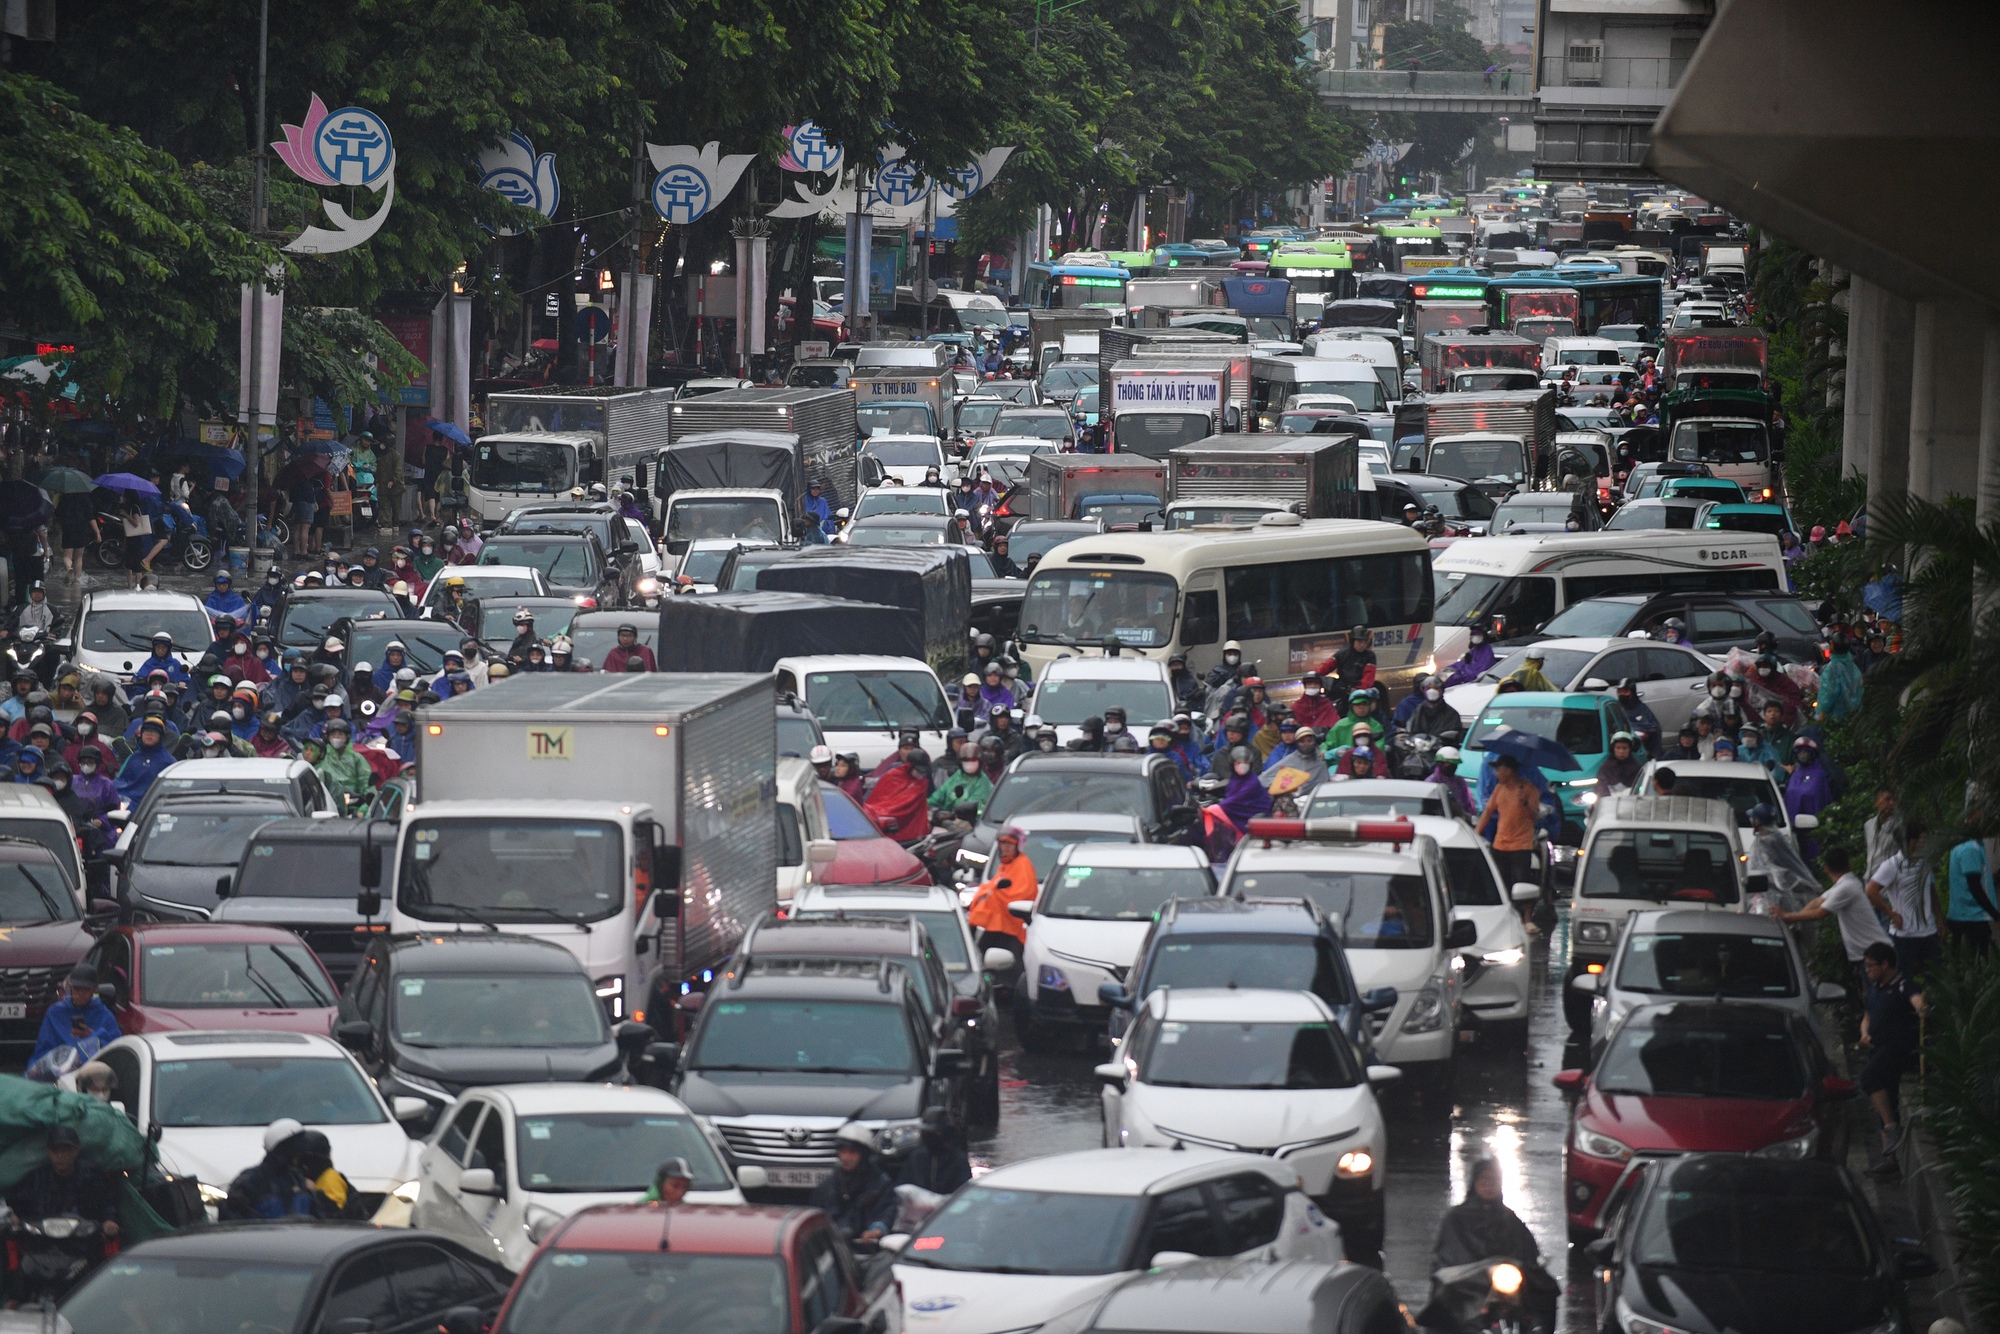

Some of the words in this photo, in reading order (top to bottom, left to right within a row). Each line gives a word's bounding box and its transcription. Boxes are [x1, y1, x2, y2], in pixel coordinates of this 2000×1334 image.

[871, 382, 882, 395] XE
[1117, 380, 1144, 401] THÔNG
[1146, 378, 1162, 401] TẤN
[1164, 380, 1176, 401] XÃ
[1178, 380, 1195, 405] VIỆT
[1197, 384, 1217, 401] NAM
[1711, 549, 1748, 560] DCAR
[1141, 629, 1153, 642] 01
[531, 730, 567, 754] TM
